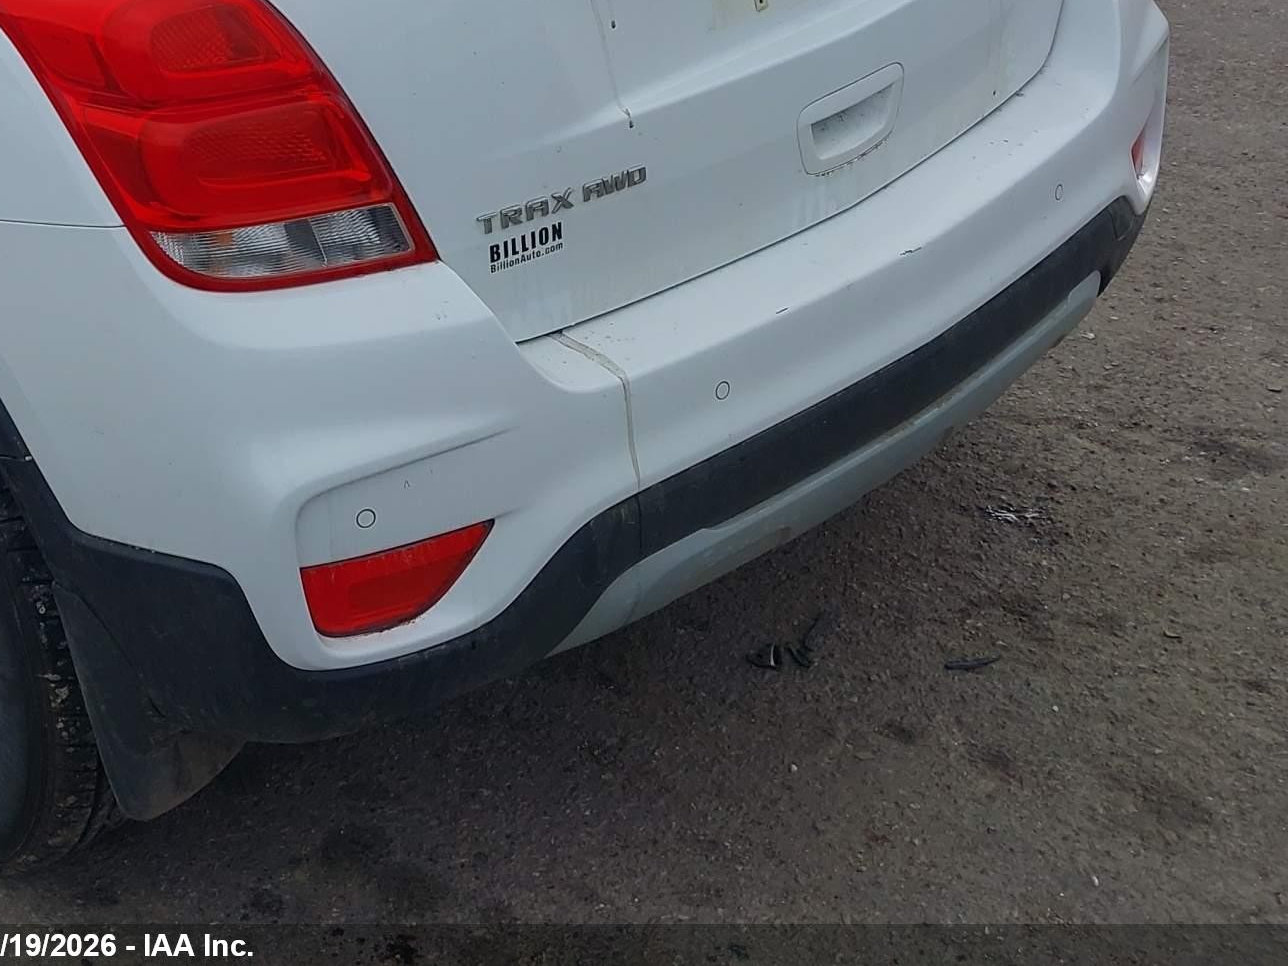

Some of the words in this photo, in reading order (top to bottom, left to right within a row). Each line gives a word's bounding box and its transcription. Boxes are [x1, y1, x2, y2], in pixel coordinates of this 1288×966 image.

[476, 187, 575, 235] TRAX
[582, 163, 647, 203] AWD
[489, 221, 563, 264] BILLION
[490, 241, 564, 274] BillionAuto.com
